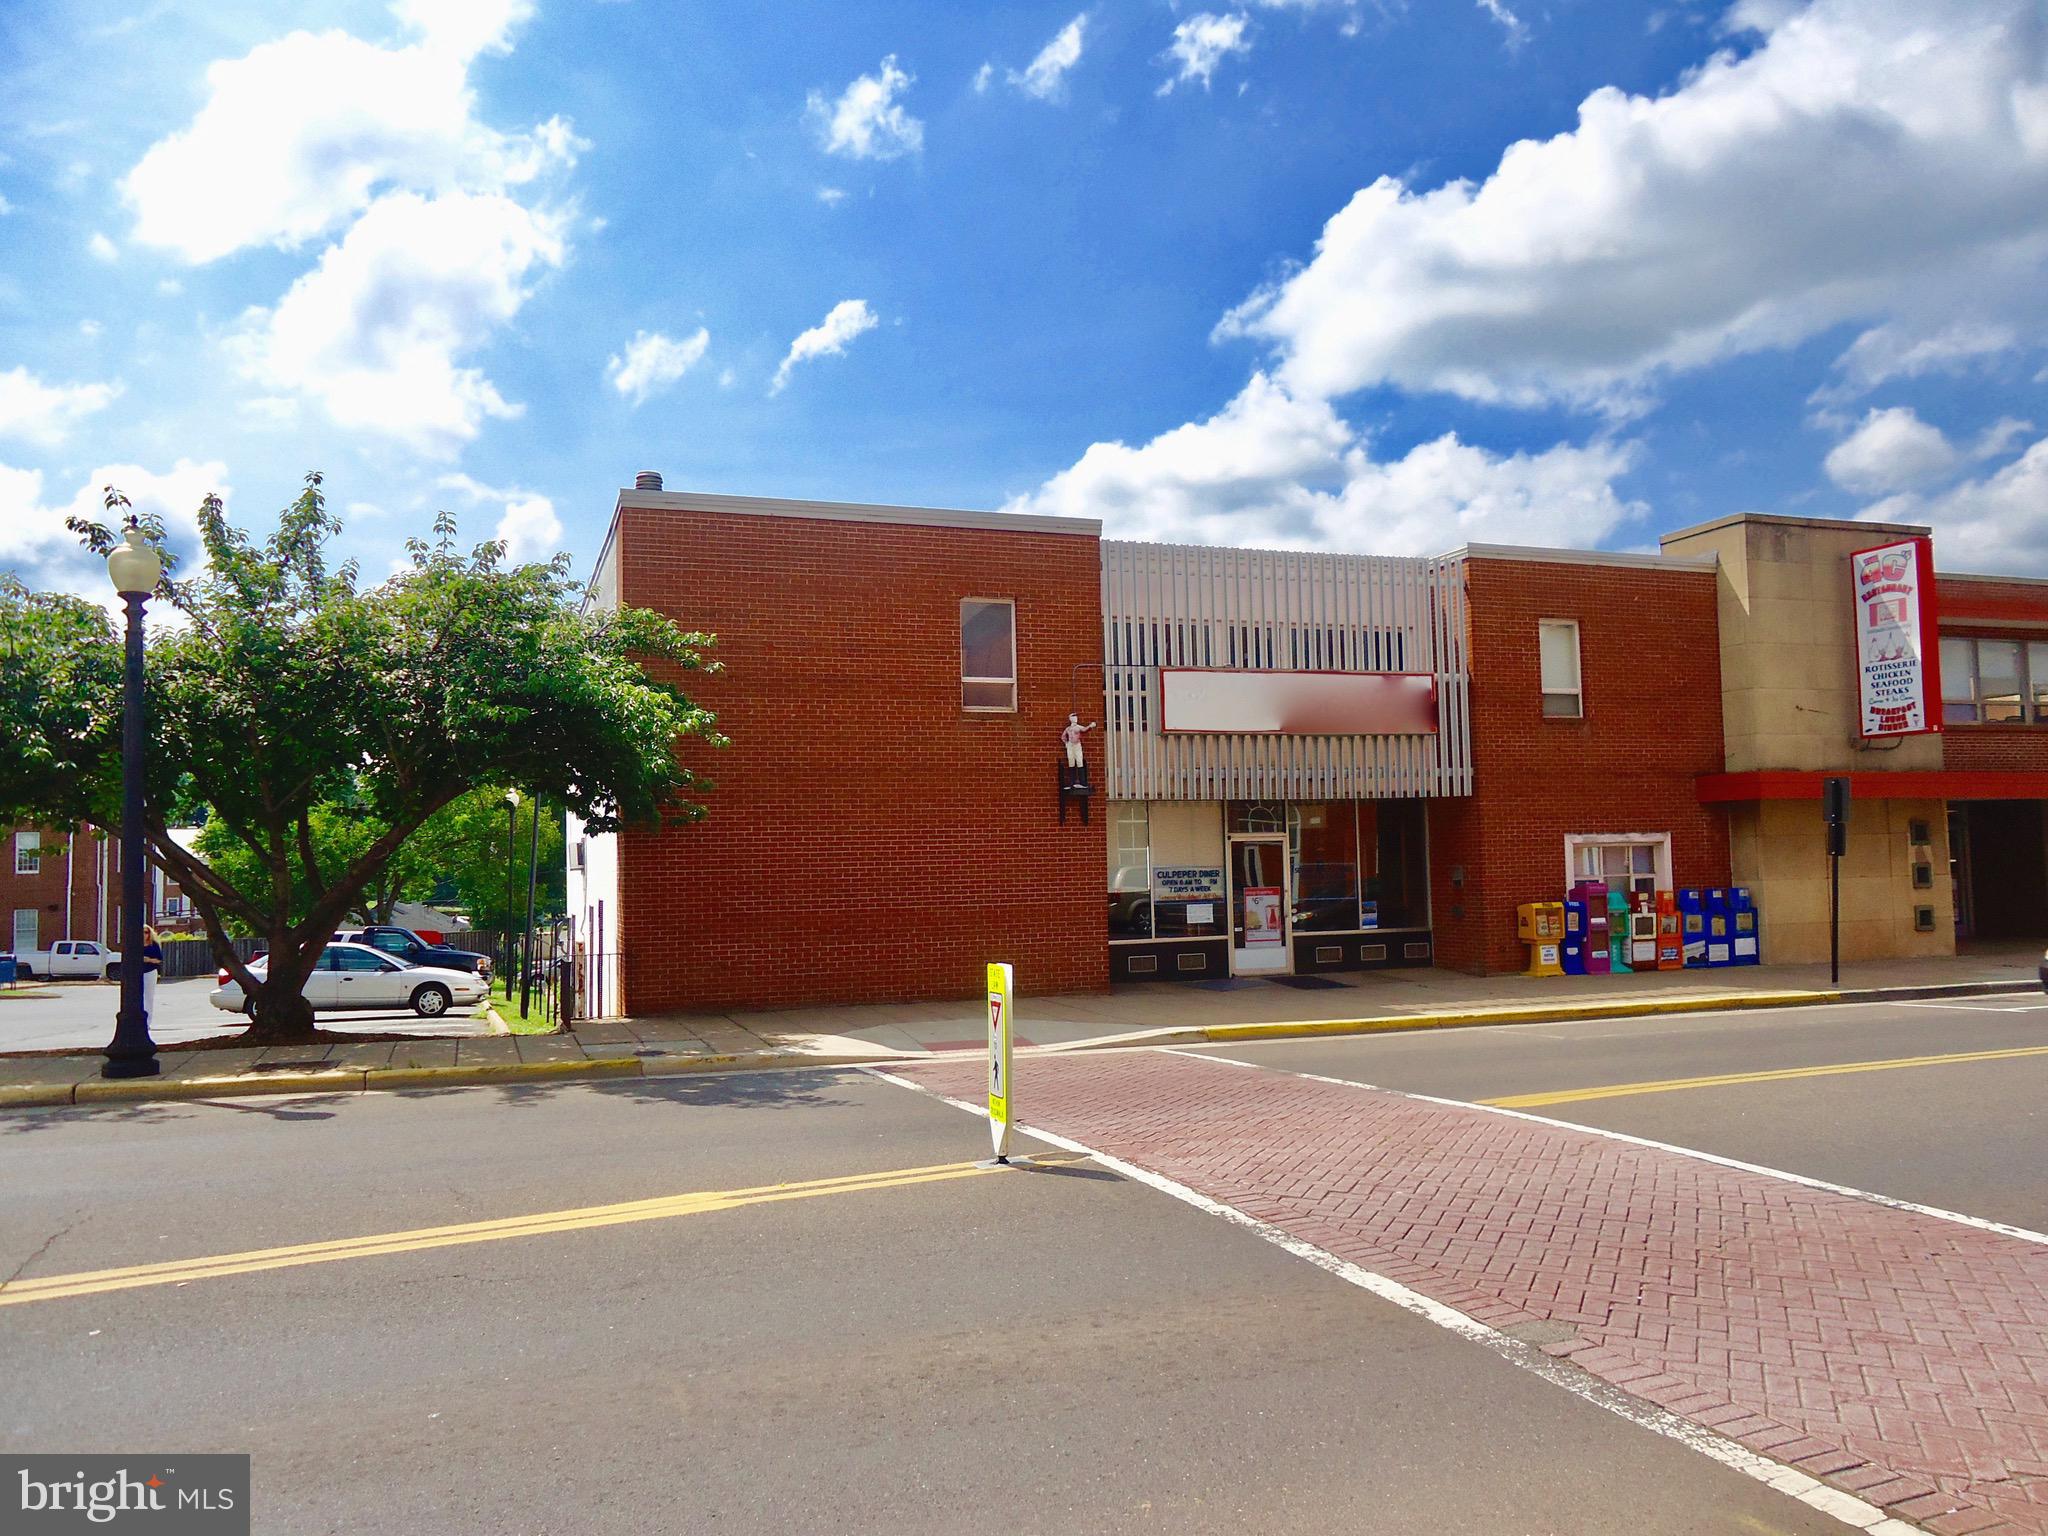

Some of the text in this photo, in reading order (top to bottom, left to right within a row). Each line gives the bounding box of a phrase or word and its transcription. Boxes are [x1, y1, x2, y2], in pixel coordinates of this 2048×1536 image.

[1865, 660, 1917, 673] ROTISSERIE
[1872, 670, 1911, 681] CHICKEN
[1871, 678, 1913, 689] SEAFOOD
[1875, 687, 1909, 697] STEAKS
[1870, 702, 1916, 715] BREAKFAST
[1157, 869, 1220, 879] CULPEPER DINER
